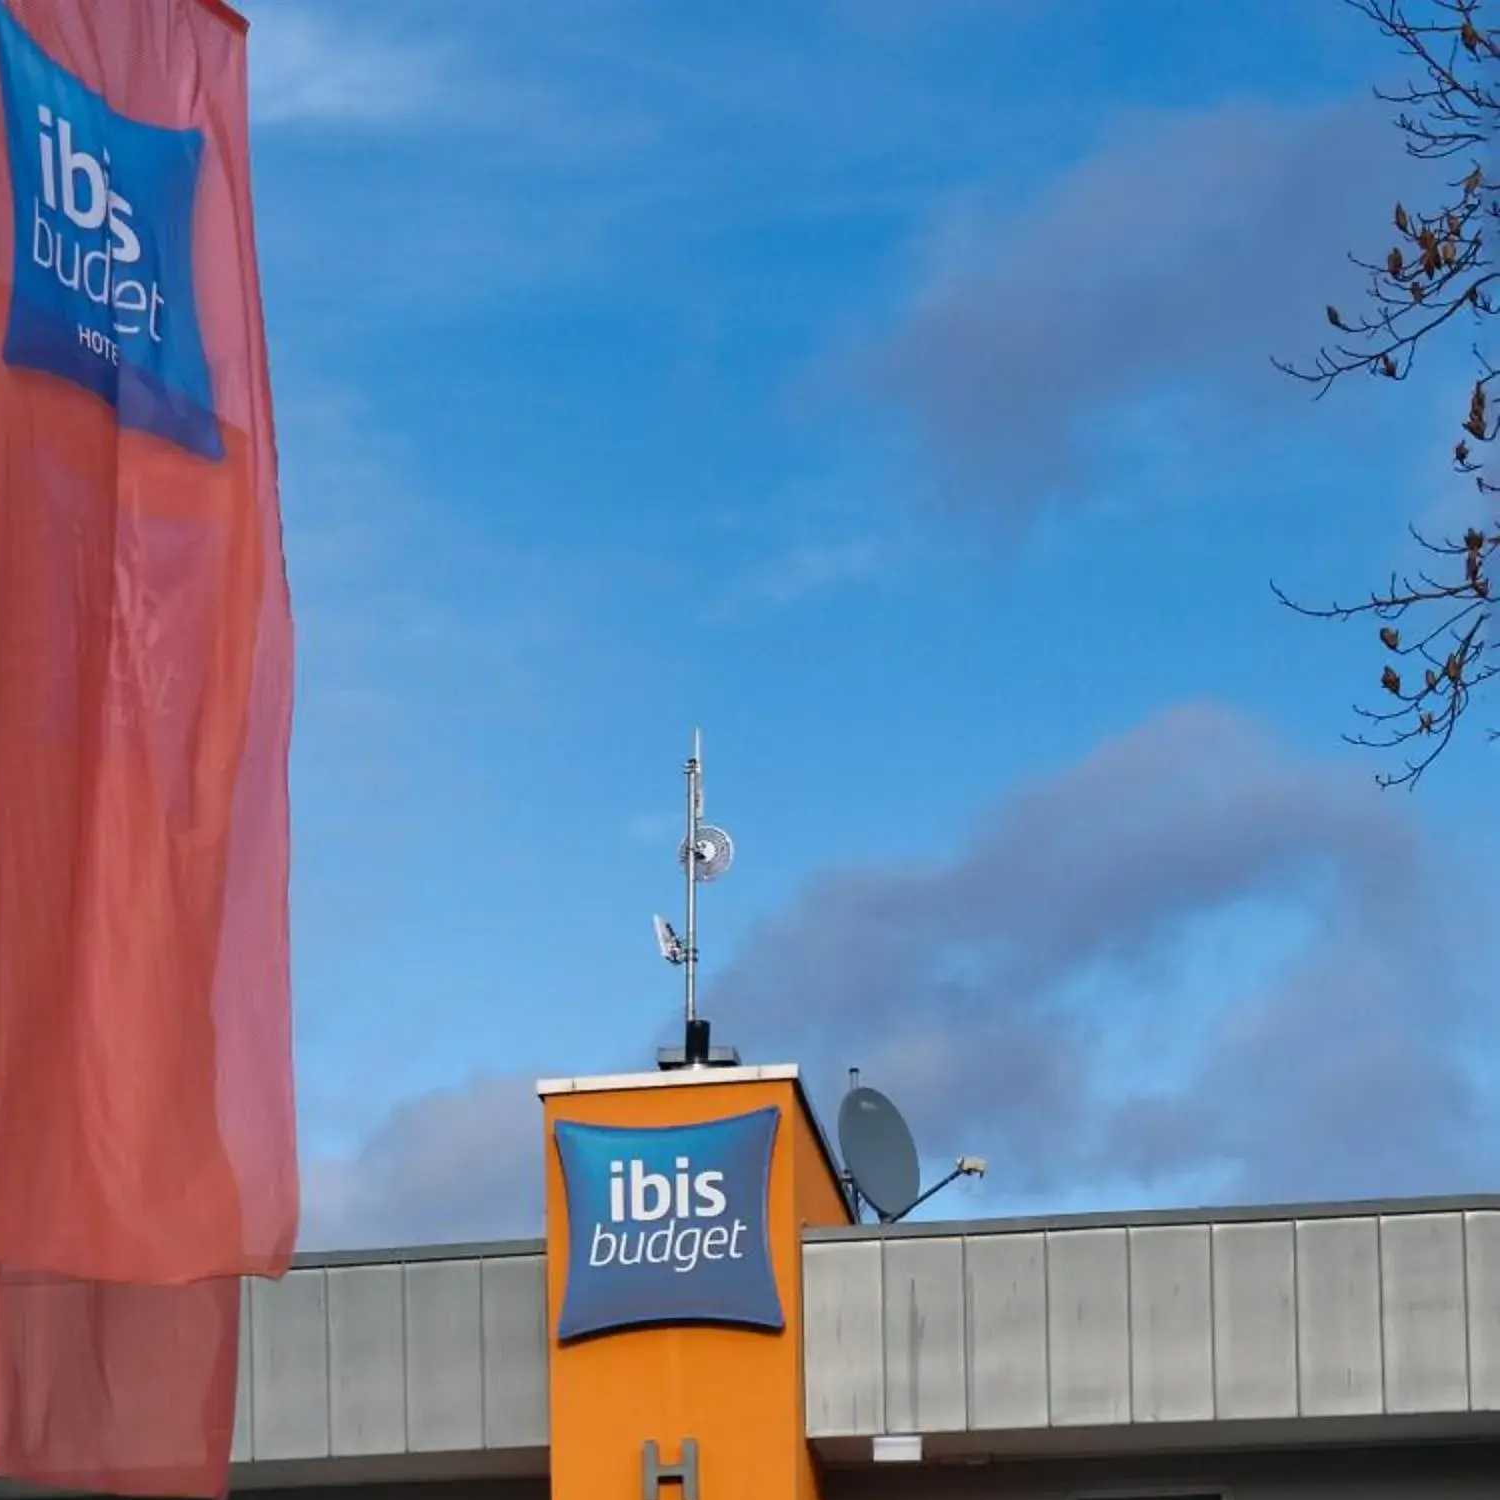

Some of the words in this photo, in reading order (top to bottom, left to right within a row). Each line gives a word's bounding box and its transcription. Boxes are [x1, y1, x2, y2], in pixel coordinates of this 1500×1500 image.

[38, 105, 140, 262] ibs
[77, 323, 119, 366] HOTE
[610, 1156, 727, 1222] ibis
[589, 1217, 748, 1273] budget
